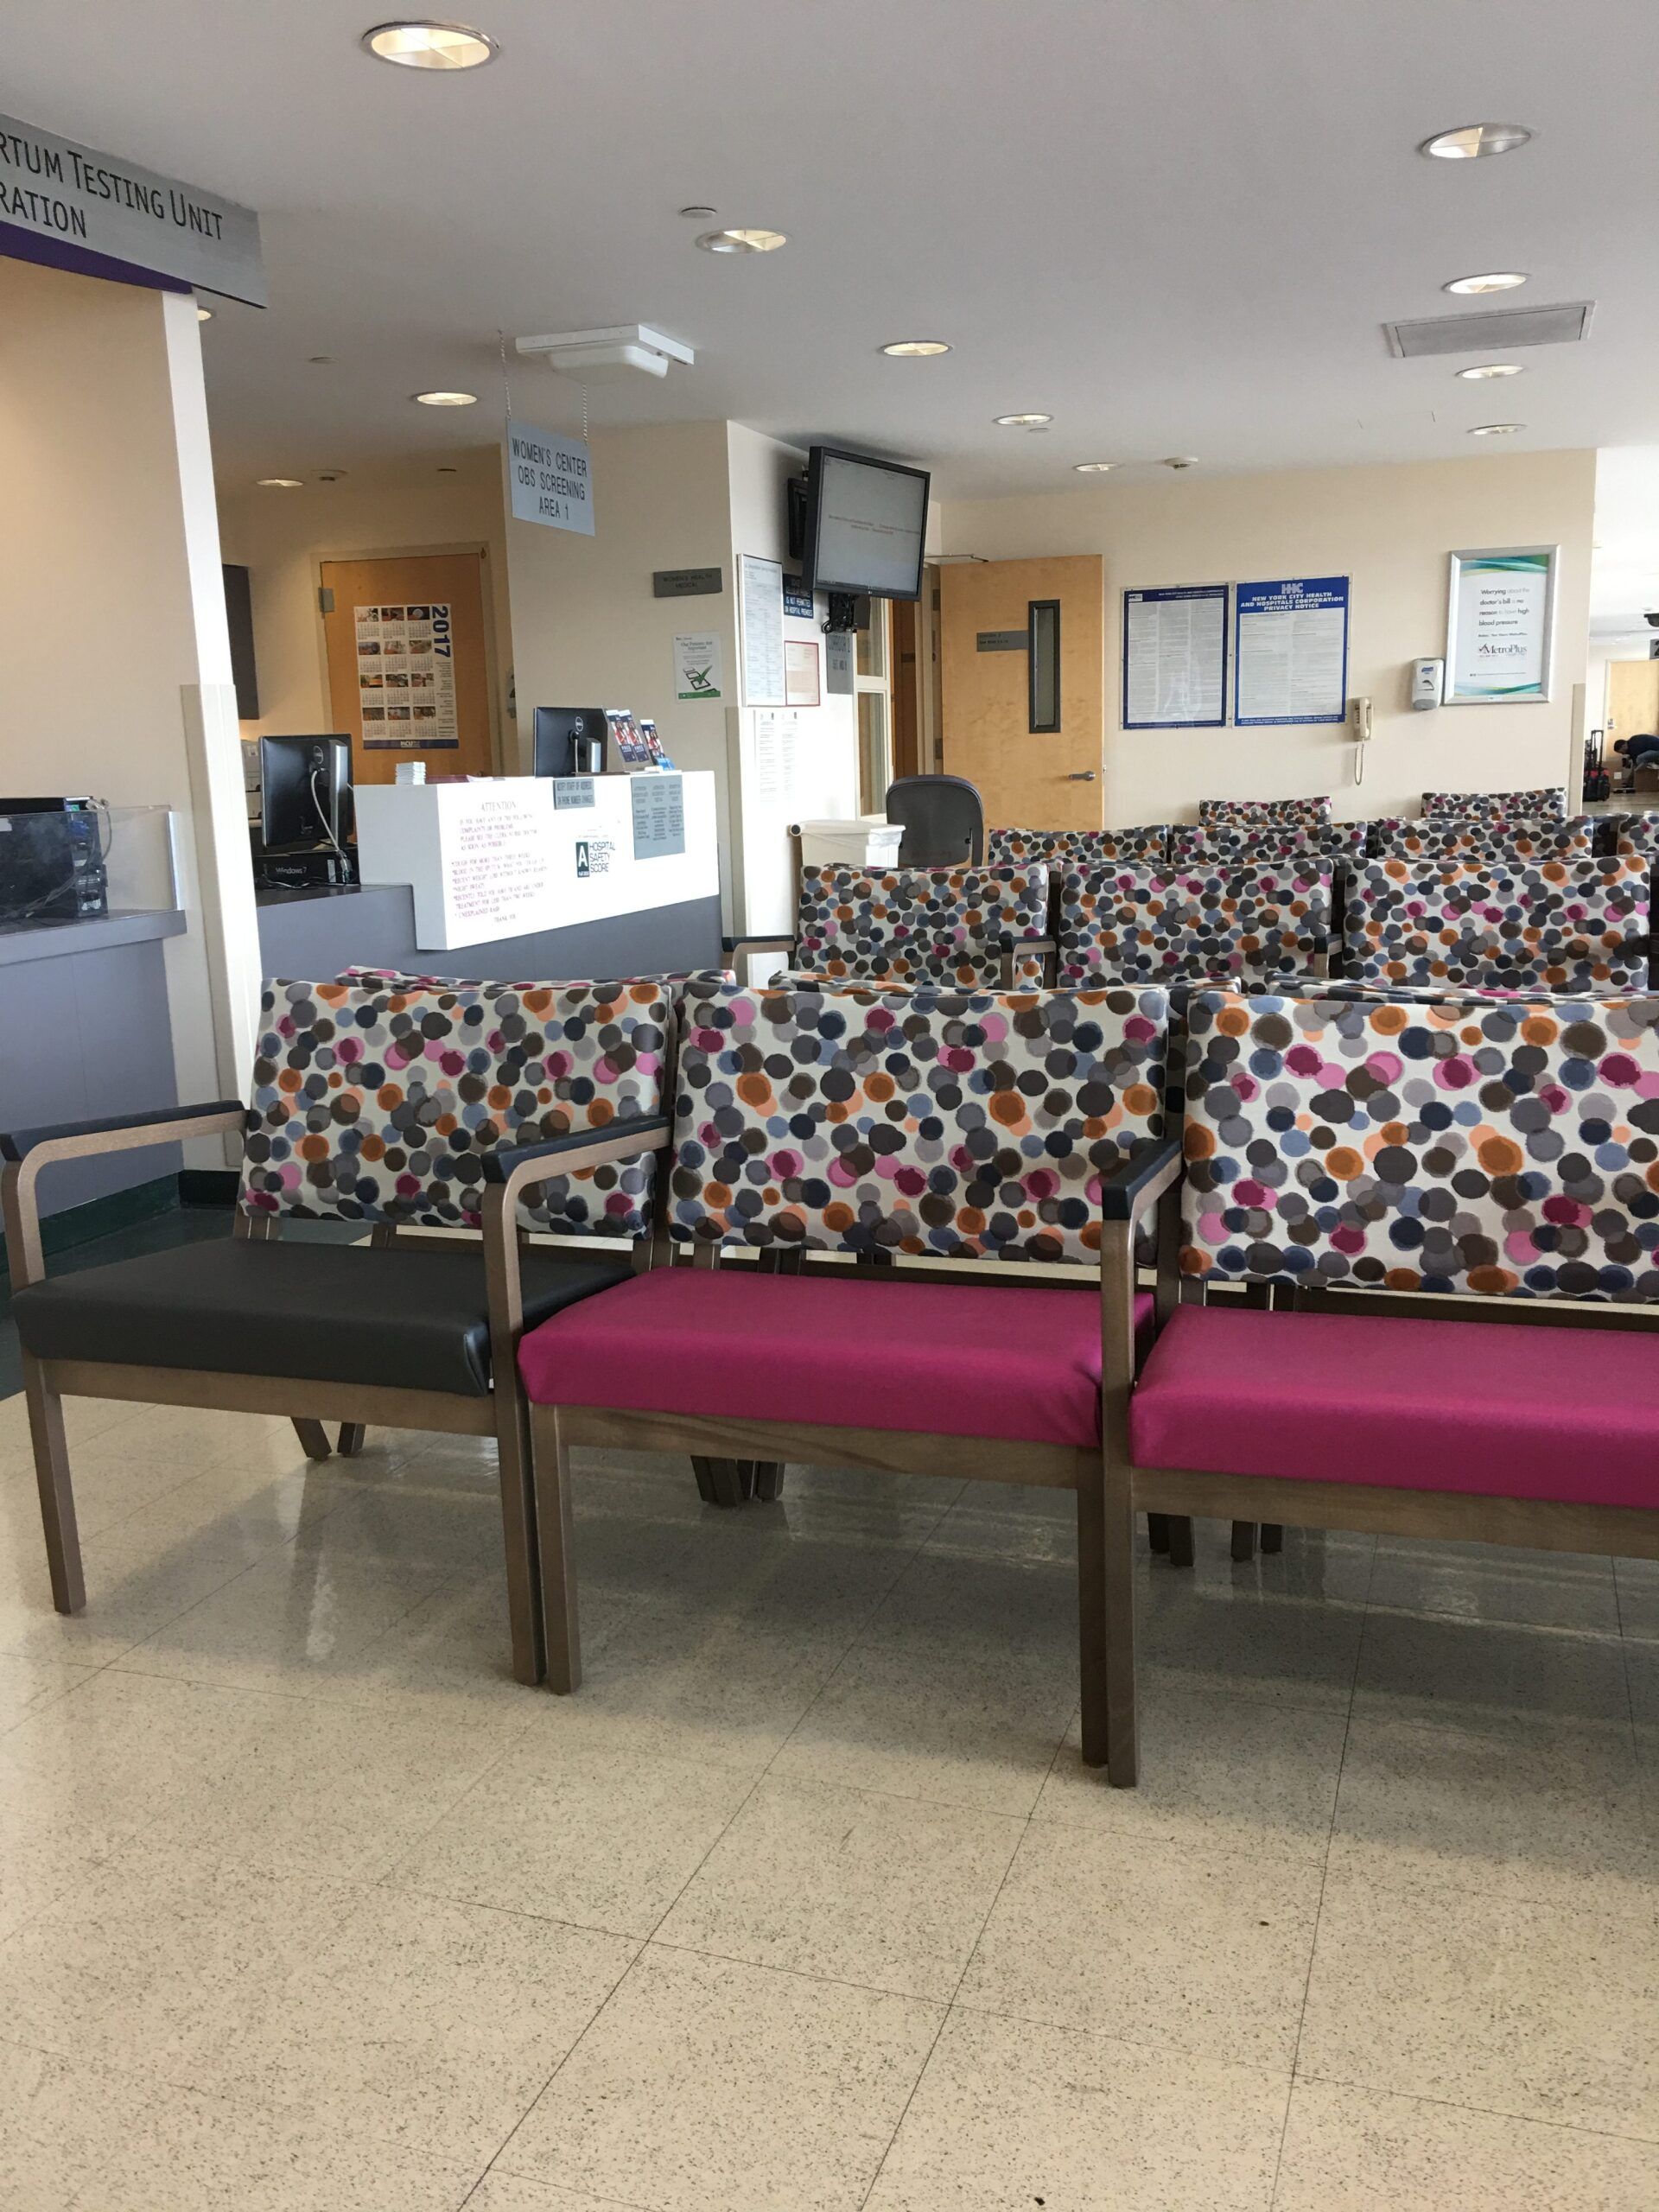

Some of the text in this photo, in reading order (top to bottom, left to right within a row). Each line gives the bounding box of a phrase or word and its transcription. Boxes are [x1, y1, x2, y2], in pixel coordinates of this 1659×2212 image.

[169, 189, 222, 240] UNIT
[512, 438, 588, 477] WOMEN'S CENTER
[518, 465, 585, 500] OBS SCREENING
[539, 496, 569, 520] AREA 1
[1281, 582, 1304, 594] HHC
[431, 606, 451, 658] 2017
[1481, 644, 1528, 655] MetroPlus
[481, 800, 517, 812] ATTENTION
[578, 841, 616, 868] A HOSPITAL
[589, 852, 610, 862] SAFETY
[590, 862, 610, 873] SCORE
